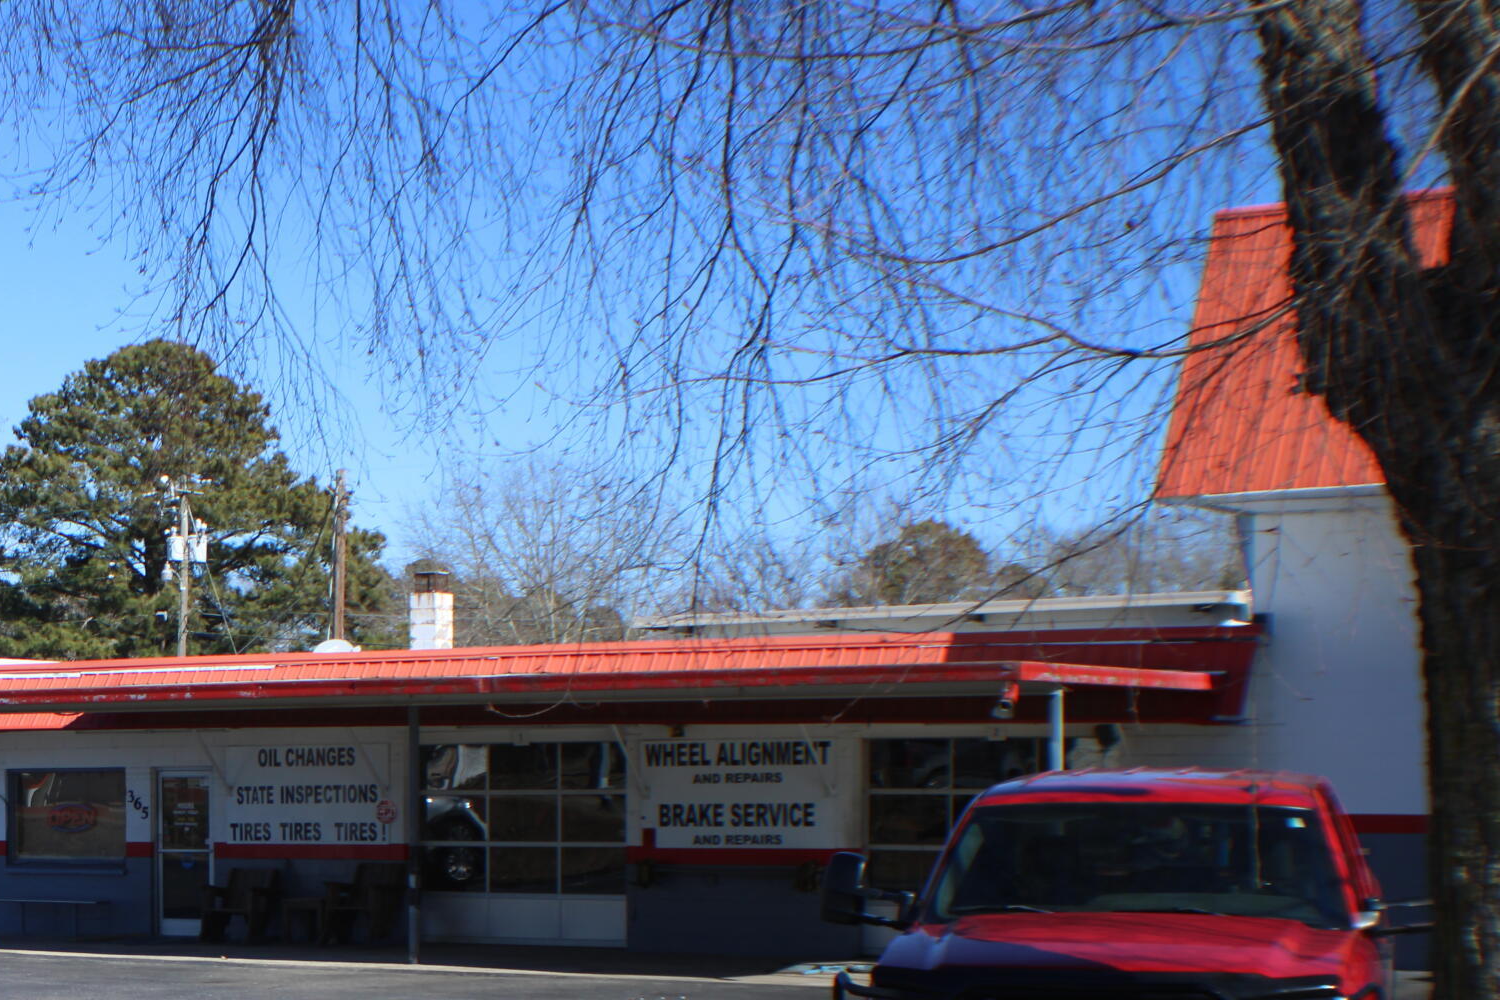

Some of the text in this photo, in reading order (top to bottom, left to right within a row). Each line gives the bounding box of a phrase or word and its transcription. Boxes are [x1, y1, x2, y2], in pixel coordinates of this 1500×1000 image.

[258, 747, 356, 767] OIL CHANGES
[645, 741, 831, 767] WHEEL ALIGNMENT
[692, 772, 783, 784] AND REPAIRS
[126, 790, 149, 819] 365
[236, 784, 378, 805] STATE INSPECTIONS
[48, 808, 97, 825] OPEN
[658, 803, 816, 827] BRAKE SERVICE
[230, 822, 271, 841] TIRES
[279, 822, 322, 841] TIRES
[692, 834, 783, 845] AND REPAIRS
